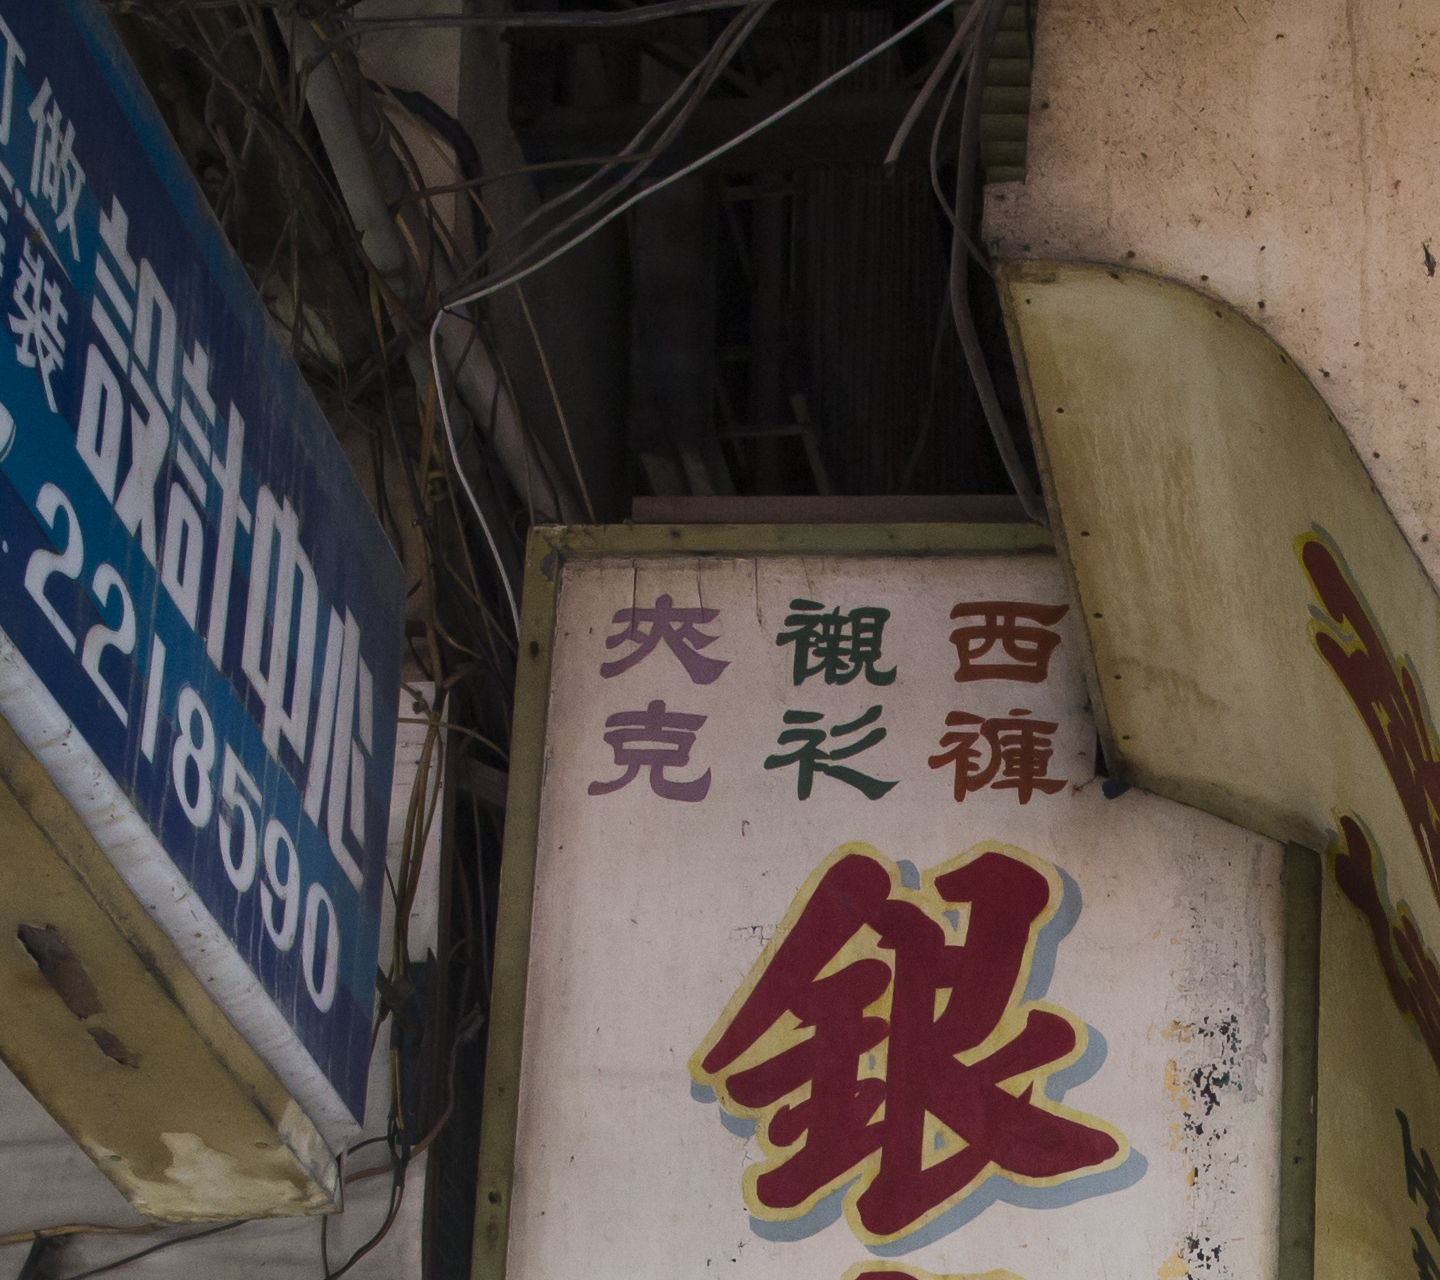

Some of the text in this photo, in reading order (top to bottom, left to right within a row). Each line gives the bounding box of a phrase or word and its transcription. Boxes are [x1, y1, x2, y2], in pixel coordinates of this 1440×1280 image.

[77, 193, 378, 890] 設計中心
[24, 482, 340, 1014] 2218590
[587, 593, 731, 803] 夾克
[762, 598, 898, 802] 襯衫
[927, 600, 1072, 806] 西褲
